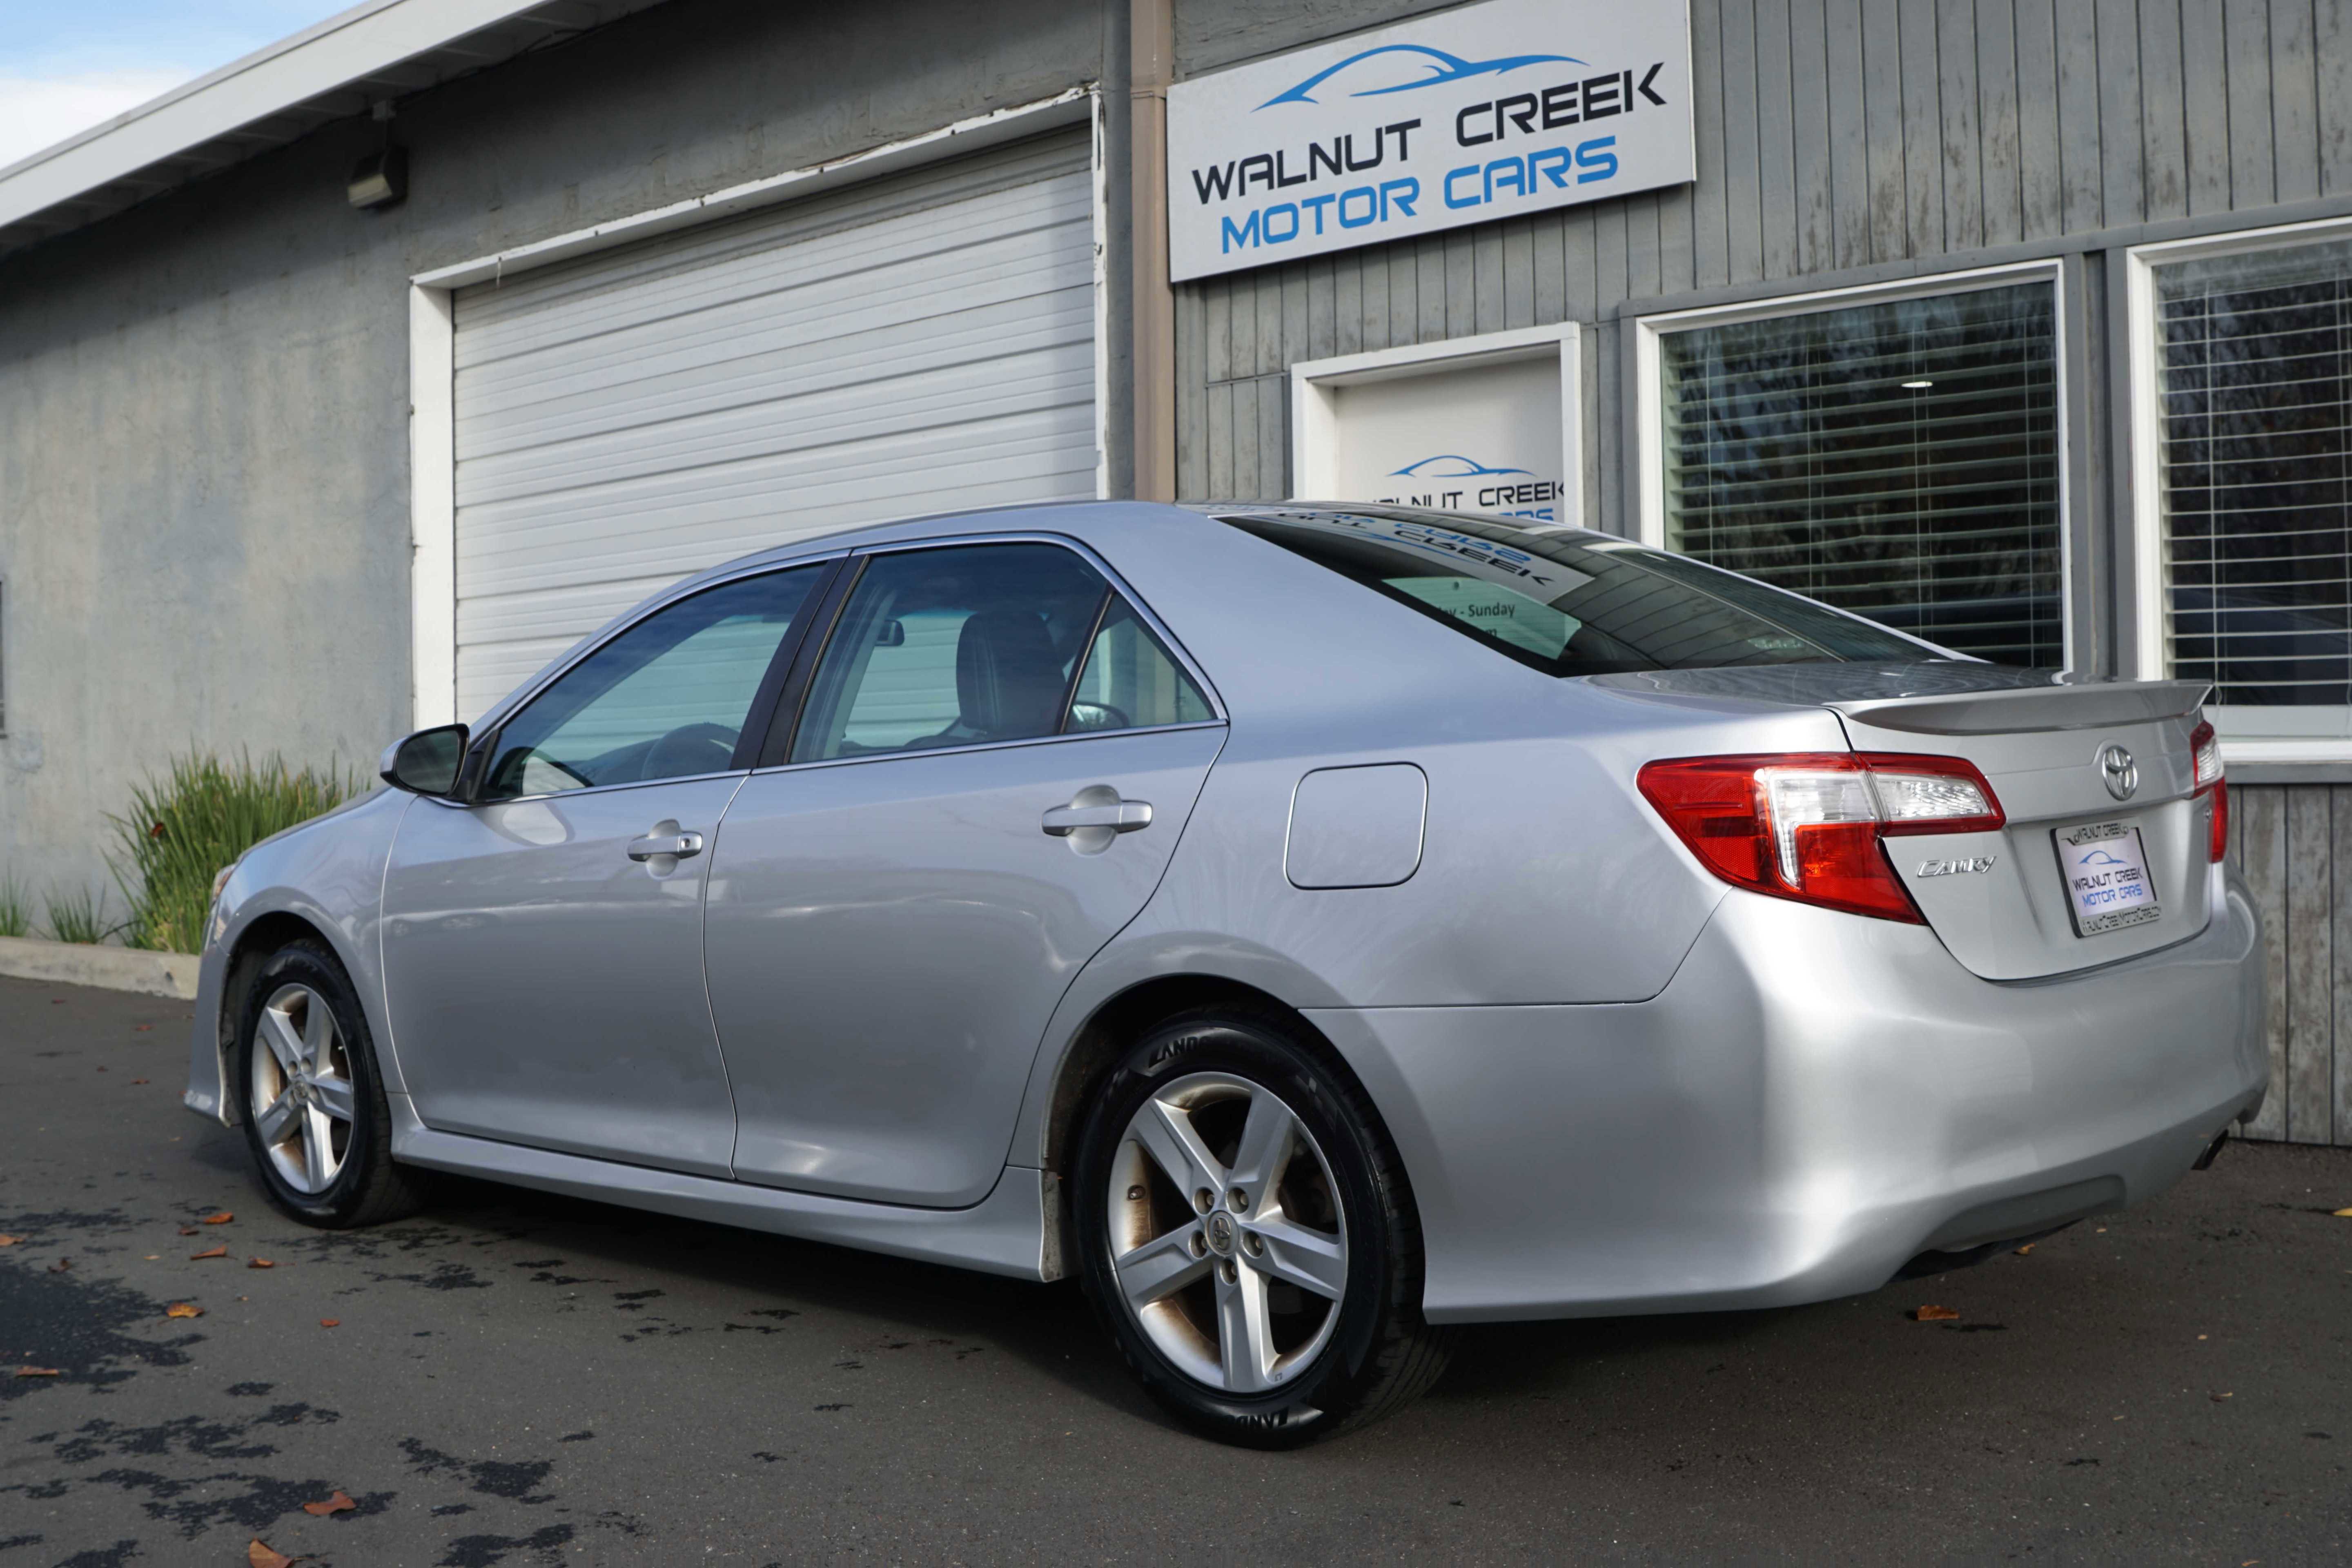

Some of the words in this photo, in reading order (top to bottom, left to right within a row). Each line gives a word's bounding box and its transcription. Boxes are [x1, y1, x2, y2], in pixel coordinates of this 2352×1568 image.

[1192, 118, 1421, 205] WALNUT
[1455, 62, 1668, 147] CREEK
[1222, 176, 1420, 254] MOTOR
[1443, 135, 1619, 210] CARS
[1479, 481, 1564, 507] CREEK
[1468, 602, 1515, 618] Sunday
[1917, 856, 1997, 878] CAMRY
[2072, 873, 2110, 891] WALNUT
[2115, 867, 2143, 883] CREEK
[2082, 889, 2116, 906] MOTOR
[2119, 884, 2143, 899] CARS
